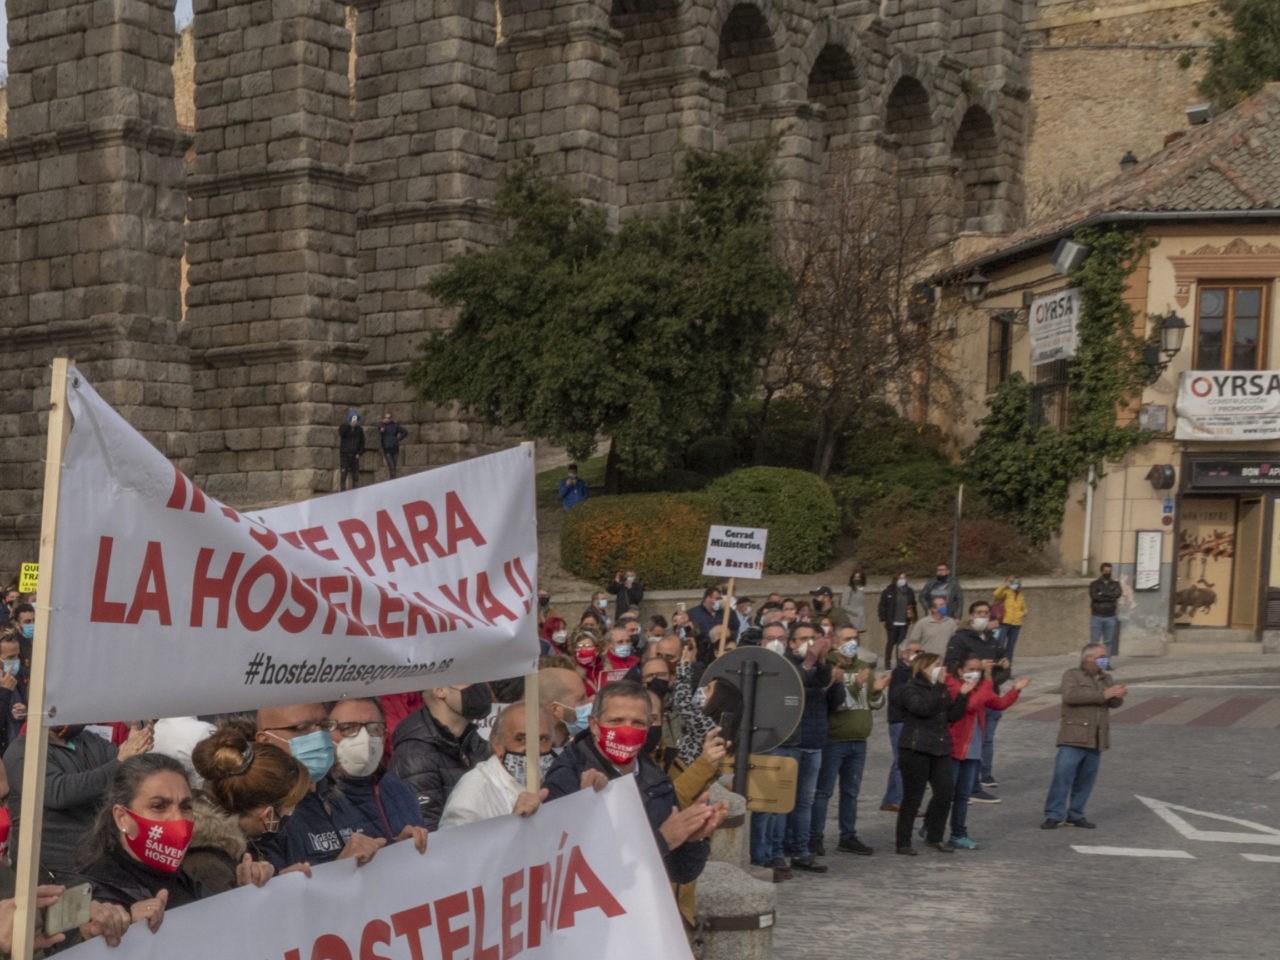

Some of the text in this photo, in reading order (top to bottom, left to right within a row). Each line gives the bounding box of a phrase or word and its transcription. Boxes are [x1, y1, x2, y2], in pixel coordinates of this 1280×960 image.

[1035, 295, 1073, 324] OYRSA
[1191, 375, 1280, 398] OYRSA
[338, 490, 487, 577] PARA
[725, 529, 754, 539] Cerrad
[710, 538, 762, 550] Ministerios,
[706, 557, 722, 566] No
[90, 535, 172, 626] LA
[148, 824, 164, 840] #
